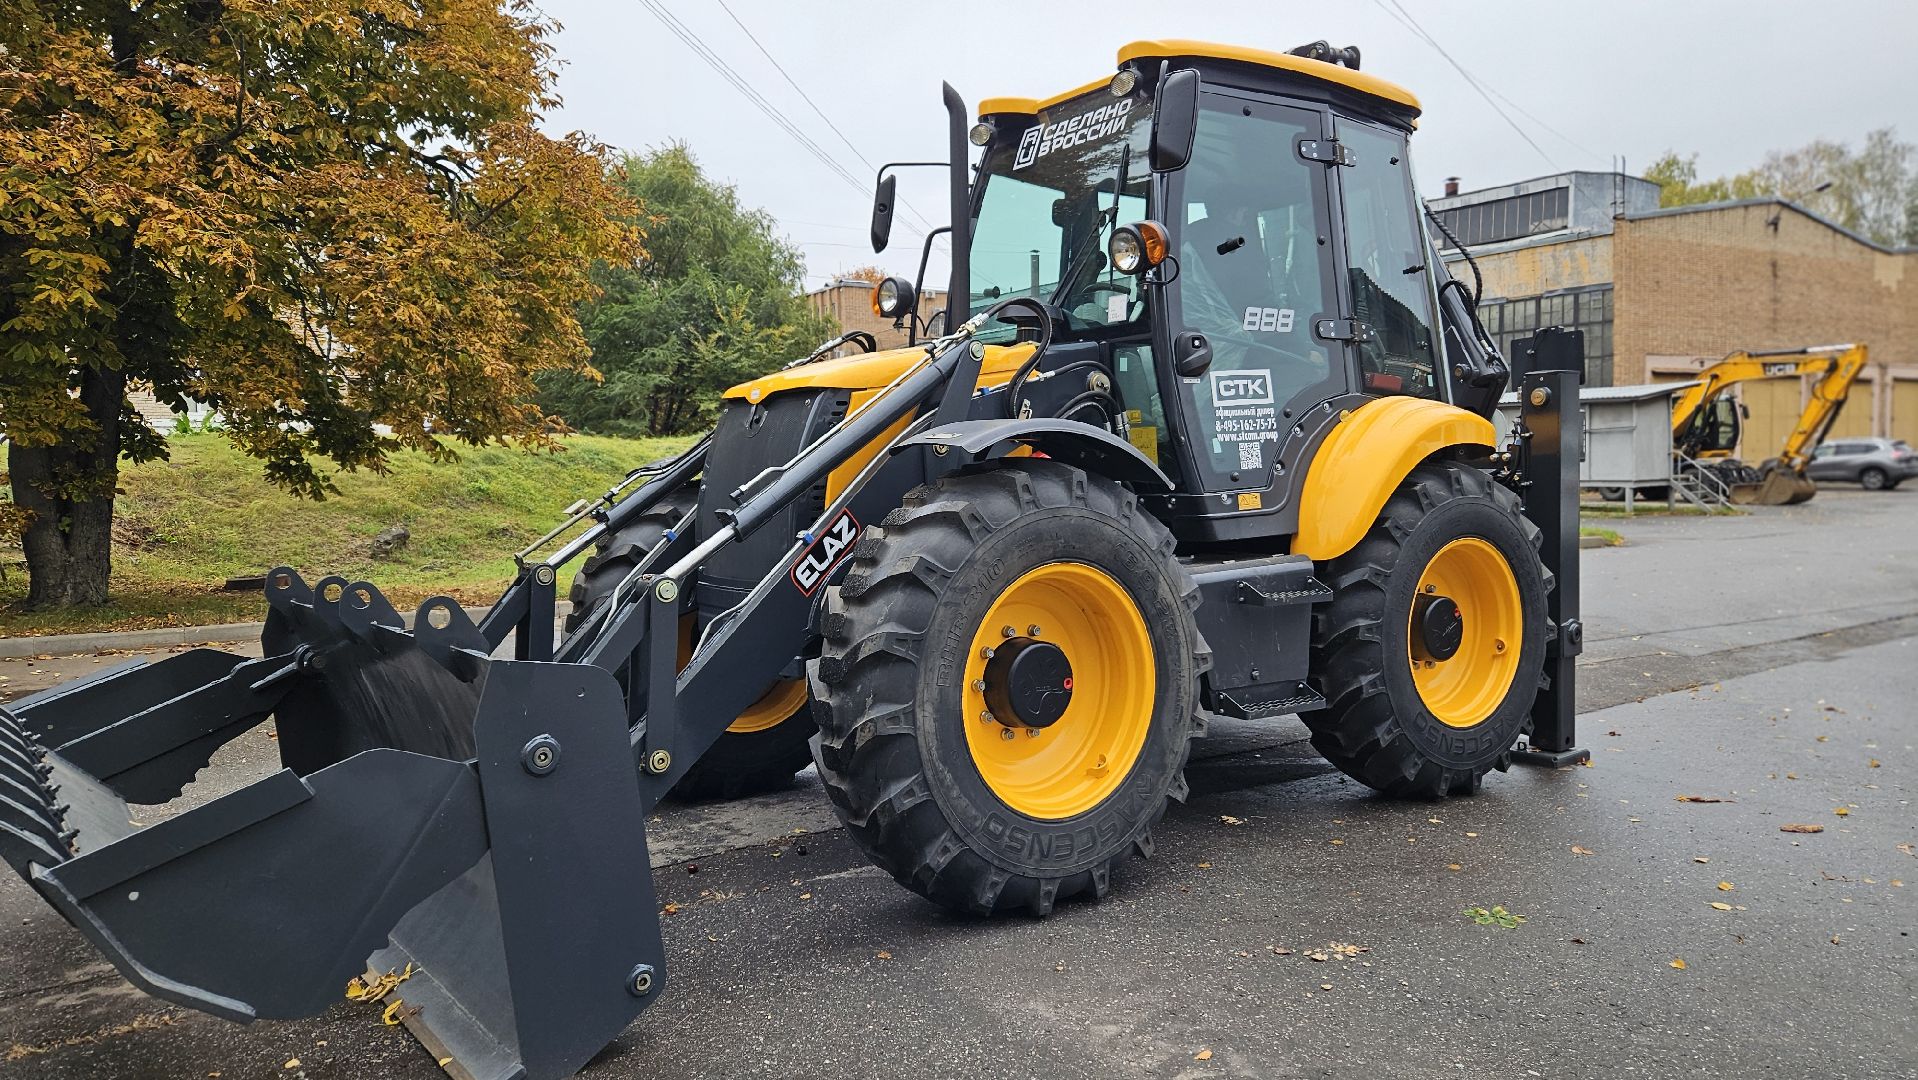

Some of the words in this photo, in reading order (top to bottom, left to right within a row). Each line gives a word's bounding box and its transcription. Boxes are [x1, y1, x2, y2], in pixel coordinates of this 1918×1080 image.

[1043, 98, 1133, 140] СДЕЛАНО
[1243, 306, 1295, 333] 888
[1218, 378, 1265, 397] СТК
[1215, 417, 1277, 432] 8-495-162-75-75
[795, 514, 856, 589] ELAZ
[1413, 711, 1504, 755] ASCENSO
[980, 798, 1147, 861] ASCENSO
